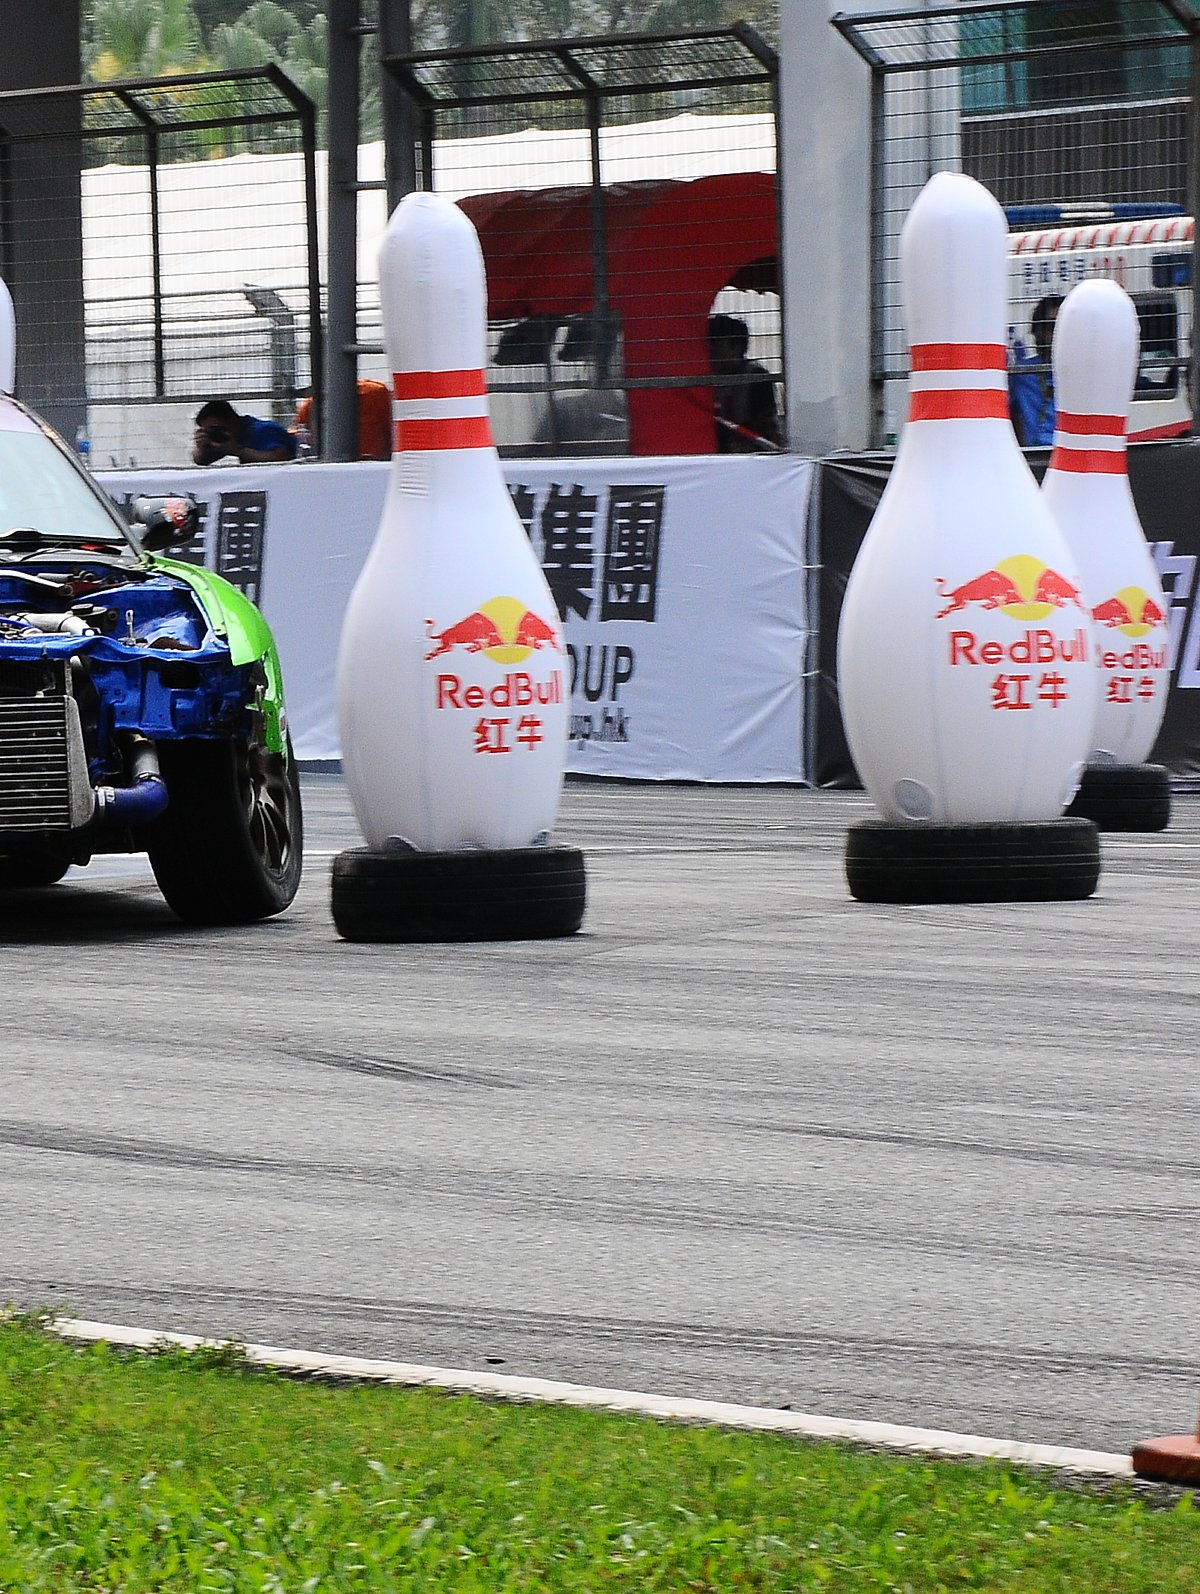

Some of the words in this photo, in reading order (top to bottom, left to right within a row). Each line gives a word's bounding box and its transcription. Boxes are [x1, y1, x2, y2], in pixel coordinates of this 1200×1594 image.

[991, 671, 1068, 710] 红牛
[1105, 675, 1156, 703] 红牛
[473, 714, 544, 753] 红牛
